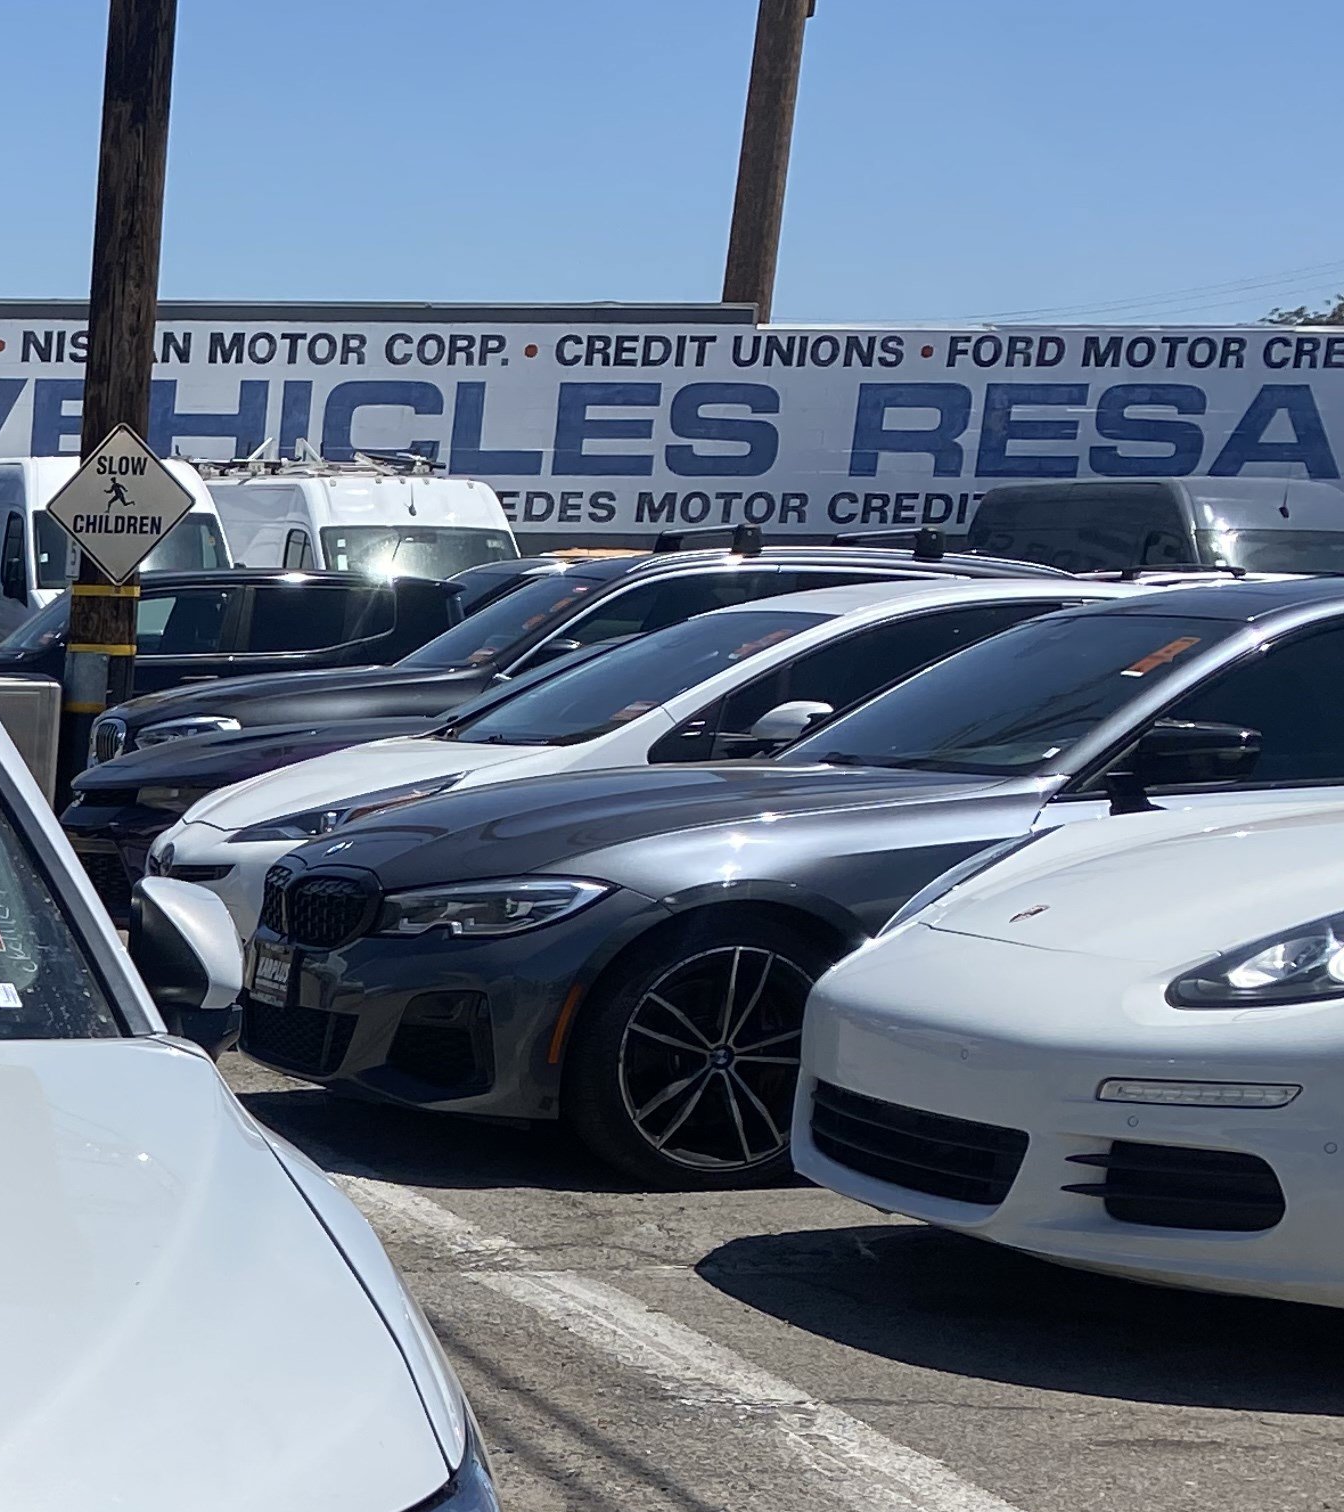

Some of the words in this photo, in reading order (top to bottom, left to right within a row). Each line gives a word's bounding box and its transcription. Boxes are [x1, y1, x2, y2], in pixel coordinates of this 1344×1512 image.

[21, 331, 192, 364] NISN
[208, 332, 366, 365] MOTOR
[385, 333, 509, 367] CORP.
[556, 335, 717, 367] CREDIT
[732, 335, 904, 368] UNIONS
[946, 336, 1065, 368] FORD
[1082, 337, 1247, 368] MOTOR
[1263, 337, 1344, 368] CRE
[849, 382, 1341, 478] RESA
[96, 455, 149, 476] SLOW
[496, 491, 616, 523] EDES
[634, 492, 809, 524] MOTOR
[73, 514, 162, 535] CHILDREN
